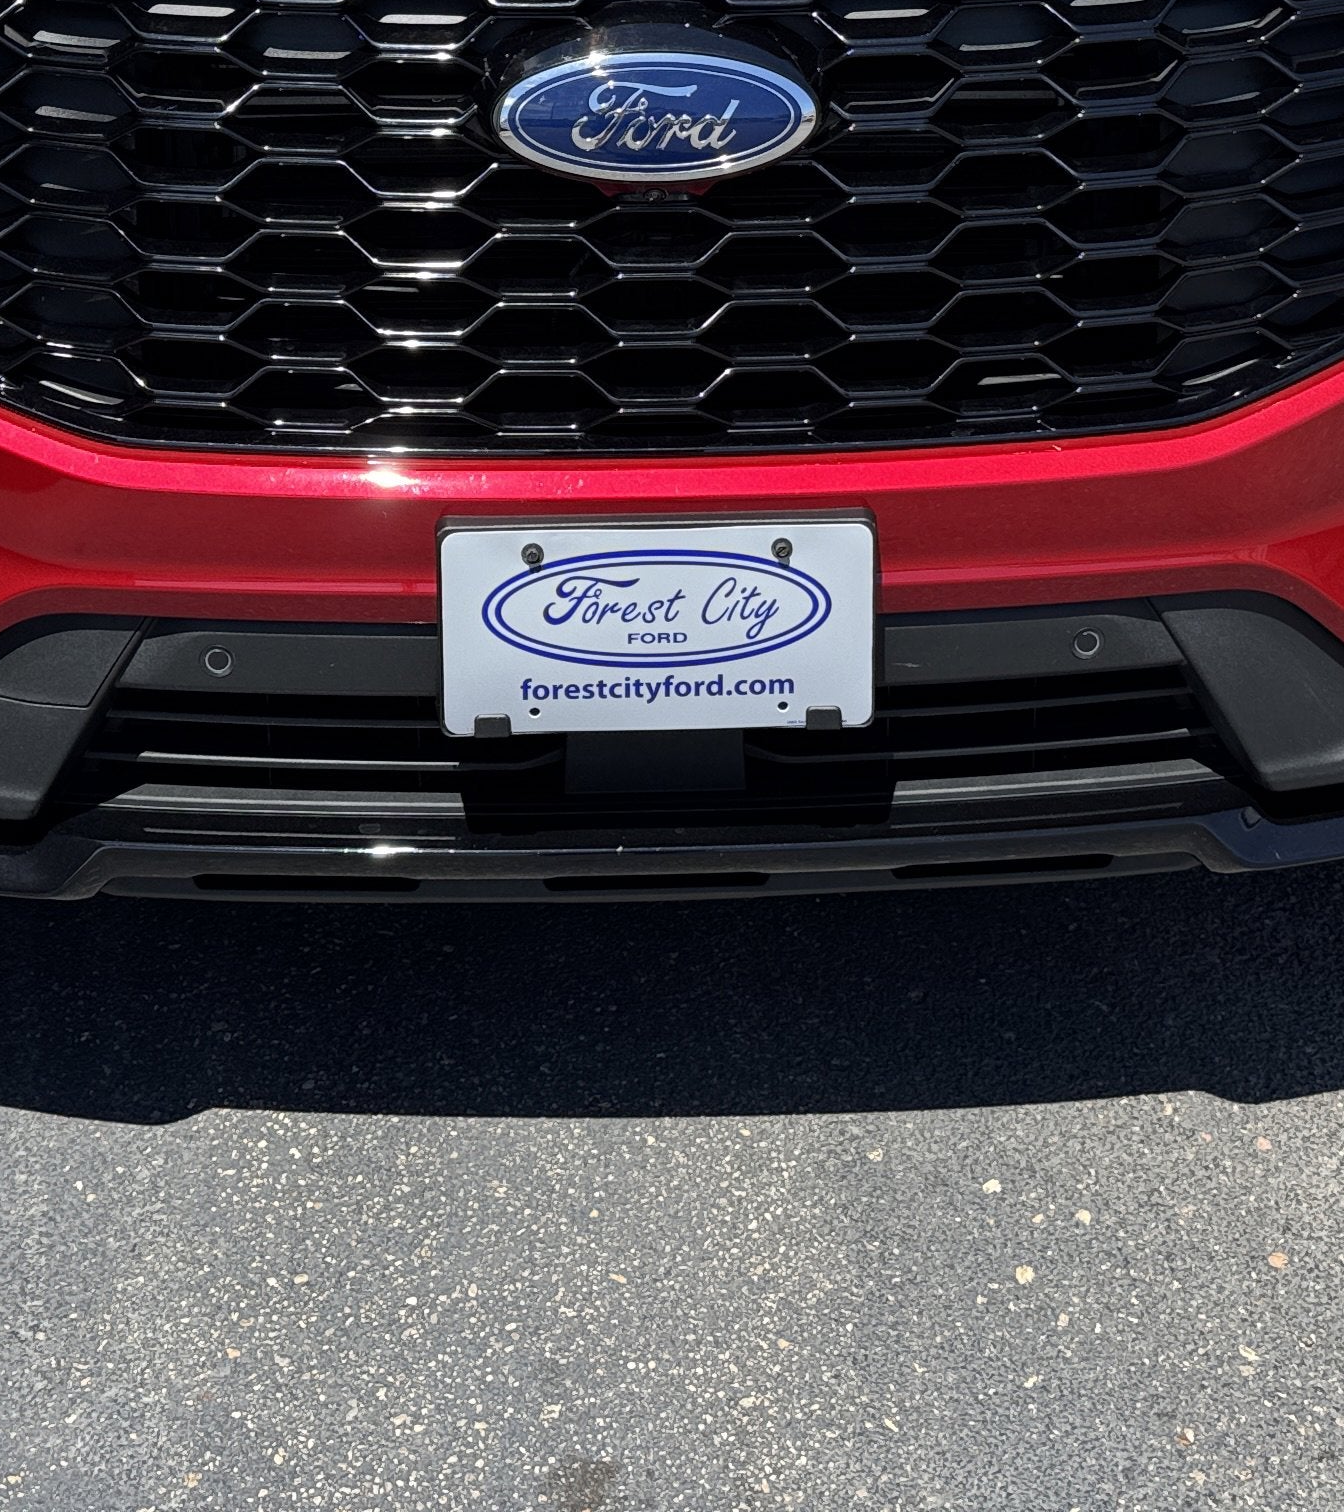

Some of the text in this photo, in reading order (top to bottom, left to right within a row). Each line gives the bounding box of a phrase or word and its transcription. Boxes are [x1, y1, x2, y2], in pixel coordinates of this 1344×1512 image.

[571, 80, 740, 152] Ford
[542, 575, 783, 640] Forest City
[627, 632, 688, 645] FORD
[520, 674, 796, 704] forestcityford.com
